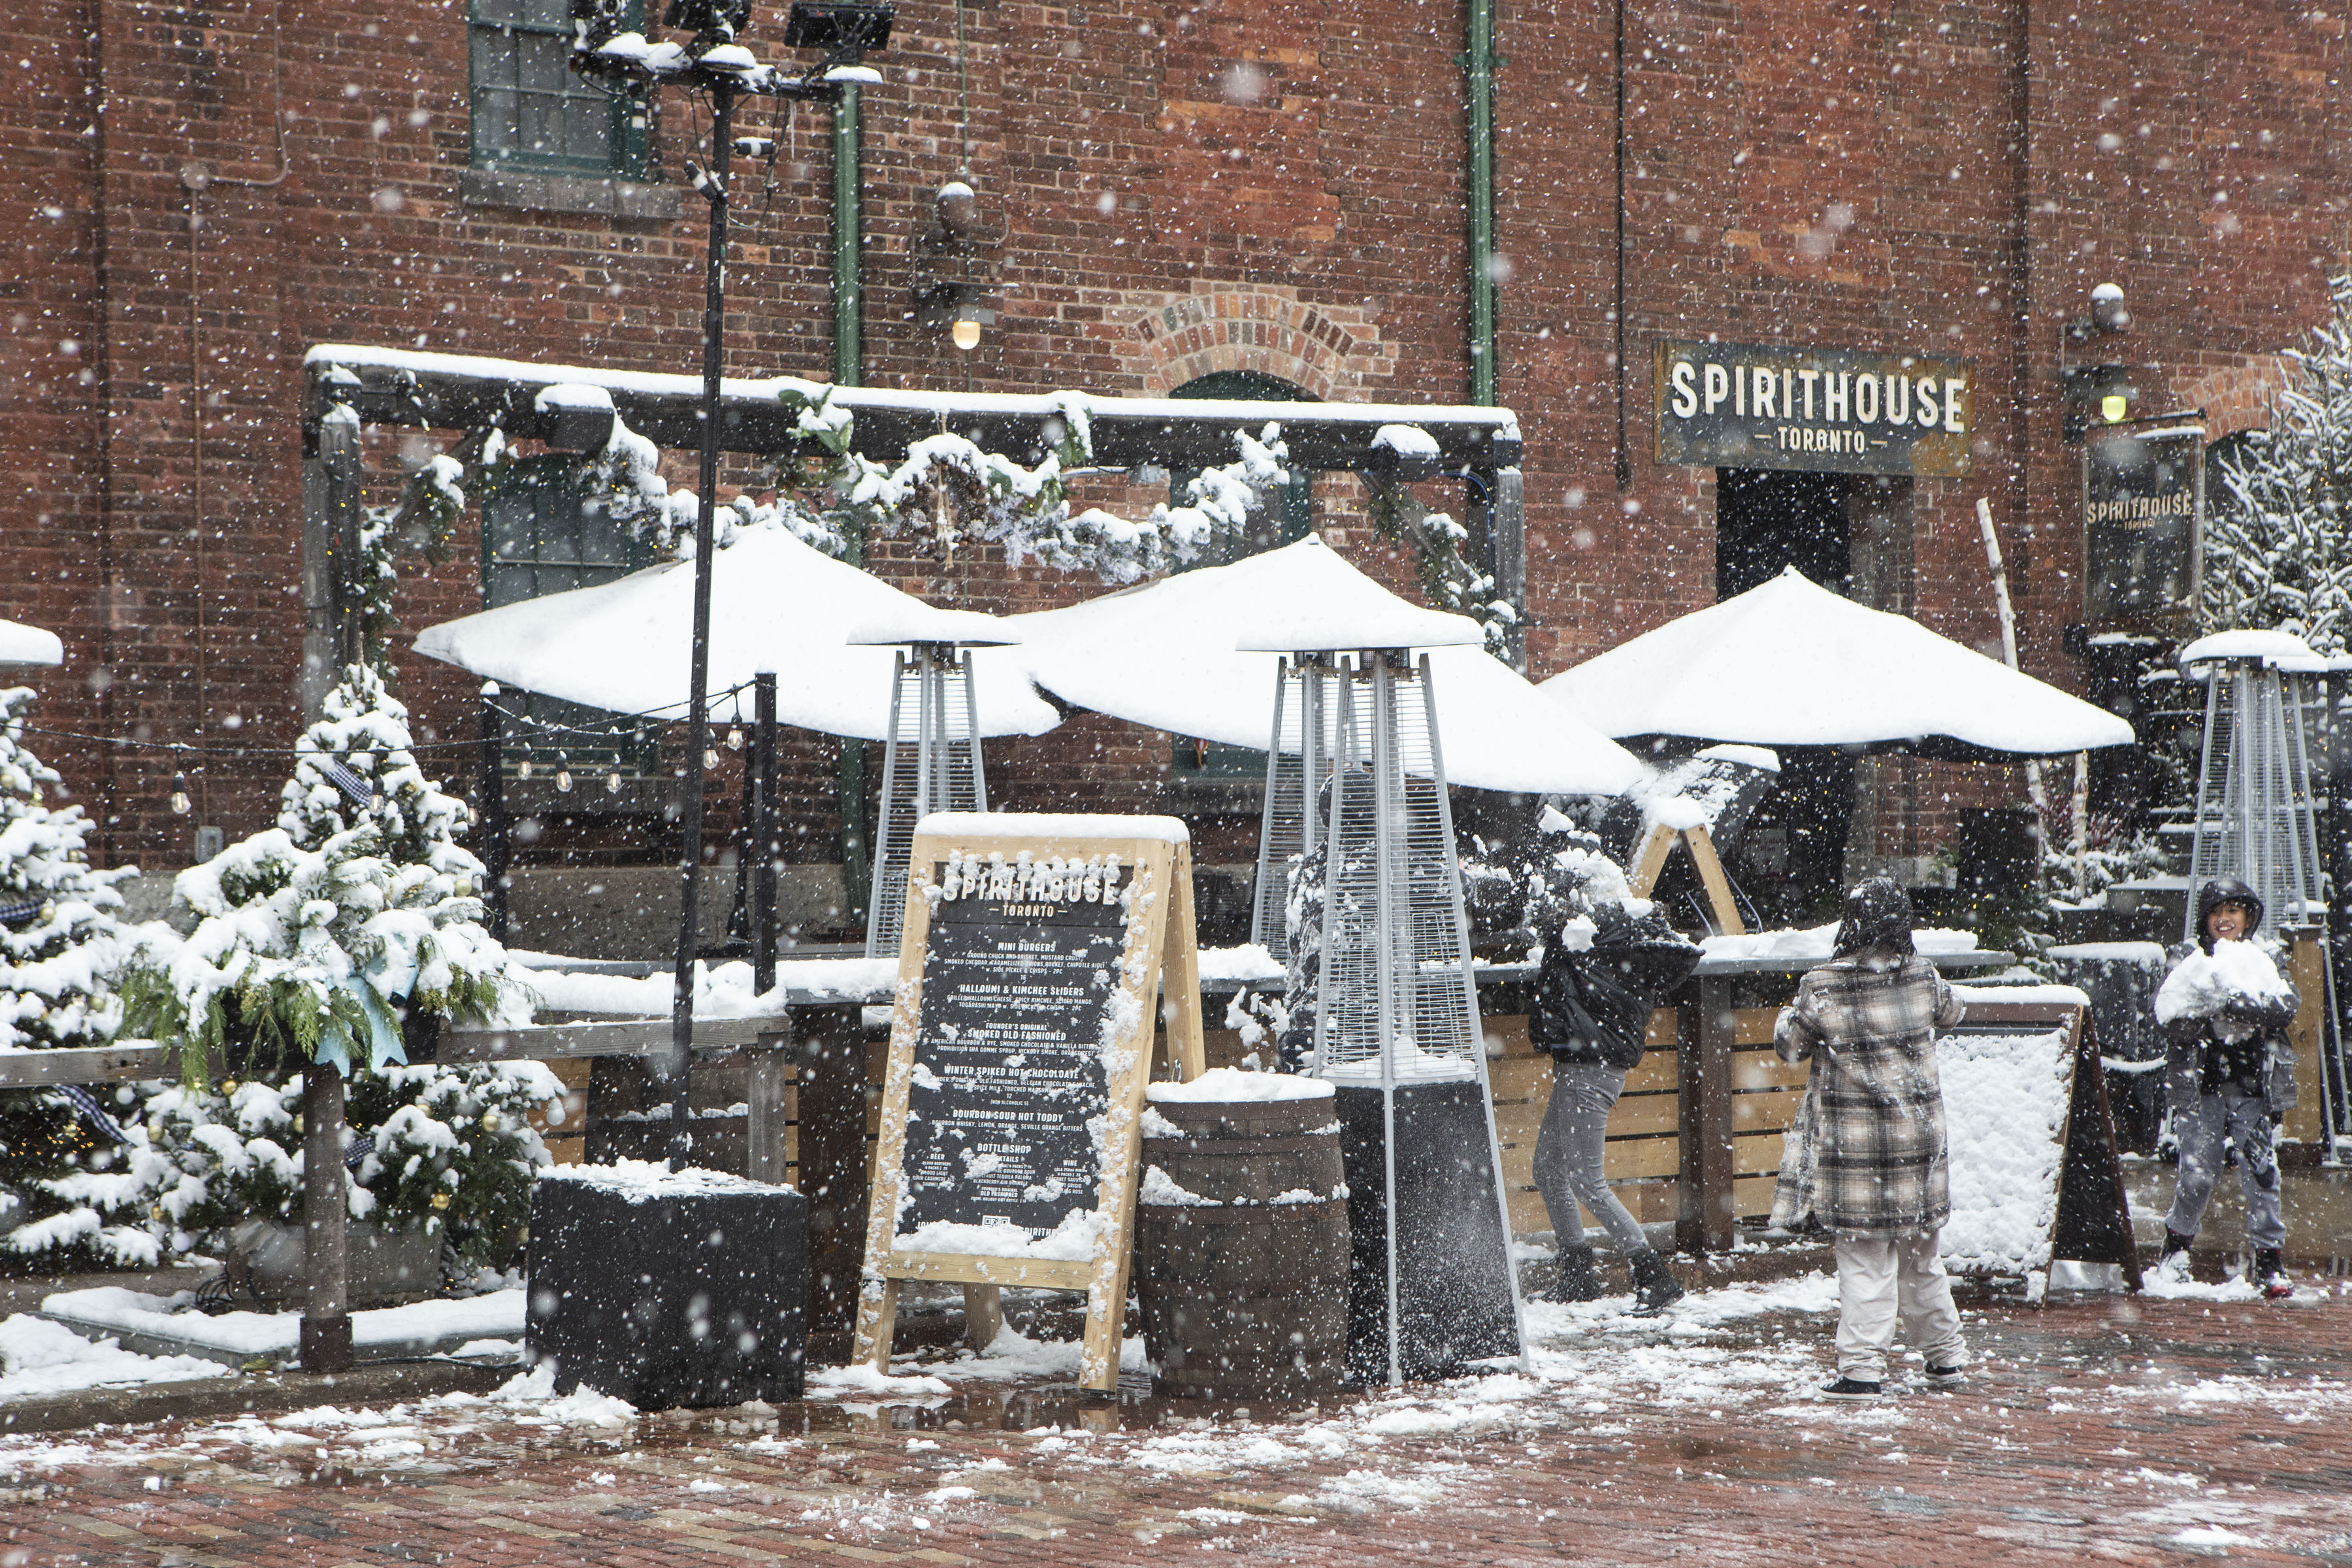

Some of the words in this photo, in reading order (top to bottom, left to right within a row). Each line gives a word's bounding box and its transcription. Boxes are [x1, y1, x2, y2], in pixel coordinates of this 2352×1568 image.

[1672, 361, 1965, 433] SPIRITHOUSE
[1778, 427, 1865, 454] TORONTO
[2087, 492, 2193, 523] SPIRITHOUSE
[943, 874, 1117, 906] SPIRITHOUSE
[1003, 904, 1054, 918] TORONTO
[998, 942, 1016, 951] MINI
[1019, 943, 1056, 953] BURGERS
[960, 984, 1001, 993] HALLOUMI
[1013, 986, 1048, 995] KIMCHEE
[1051, 987, 1085, 996] SLIDERS
[968, 1029, 1000, 1039] SMOKED
[1003, 1031, 1019, 1039] OLD
[1021, 1032, 1066, 1041] FASHIONED
[944, 1066, 974, 1075] WINTER
[977, 1067, 1006, 1076] SPIKED
[1008, 1068, 1024, 1077] HOT
[953, 1109, 991, 1119] BOURBON
[994, 1111, 1016, 1120] SOUR
[1019, 1113, 1034, 1121] HOT
[1037, 1113, 1063, 1122] TODDY
[977, 1143, 1007, 1153] BOTTLE
[1009, 1145, 1031, 1154] SHOP
